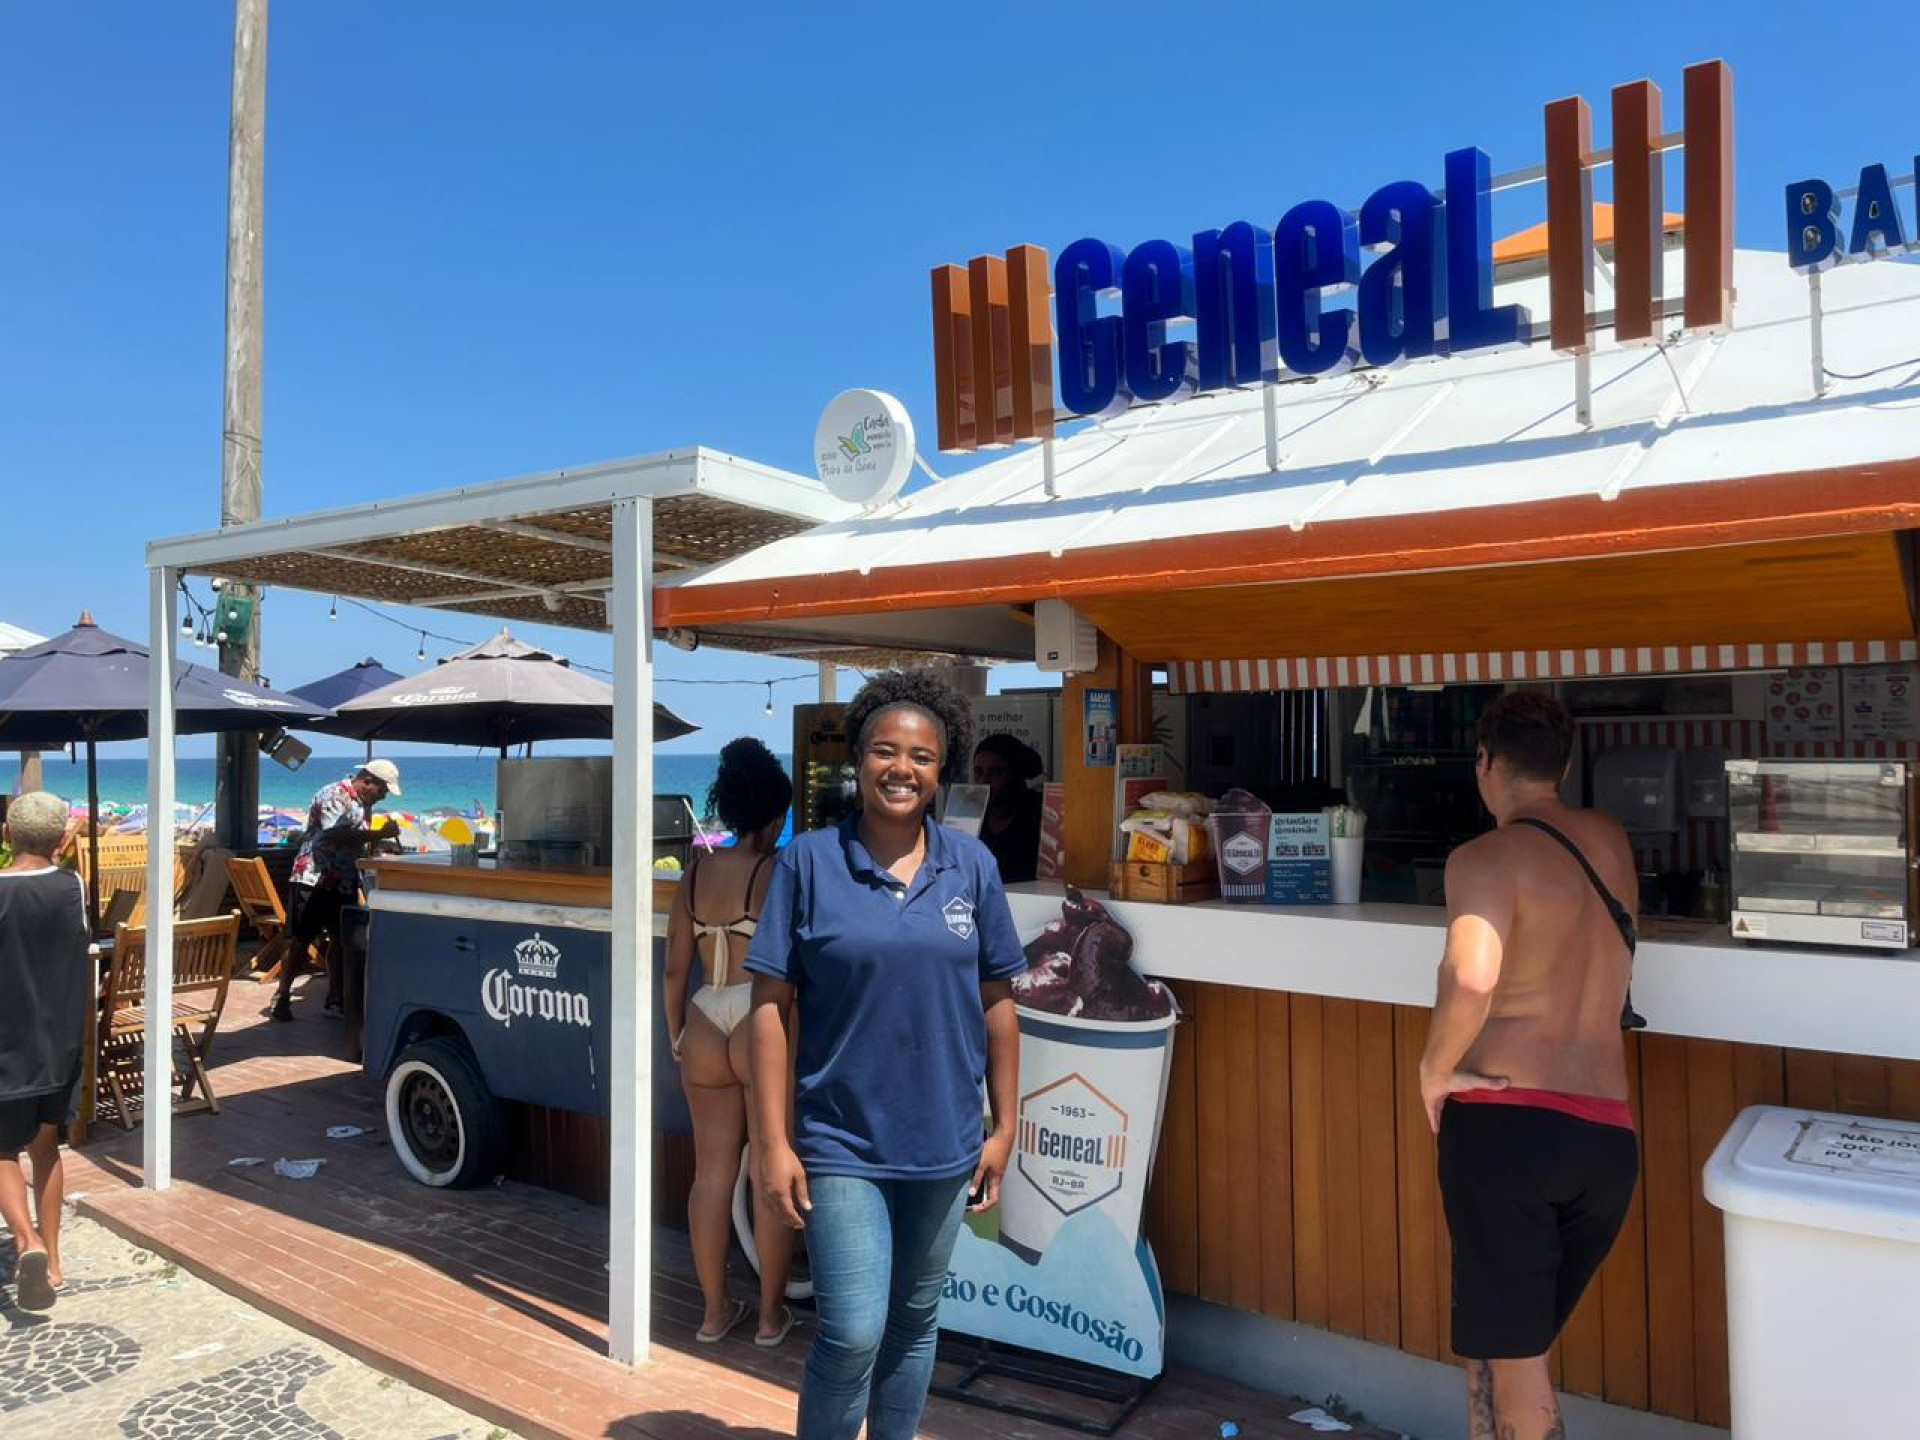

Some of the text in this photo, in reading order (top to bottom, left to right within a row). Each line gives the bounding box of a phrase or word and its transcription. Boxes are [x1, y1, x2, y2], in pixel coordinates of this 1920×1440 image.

[1786, 156, 1920, 268] BA
[482, 967, 592, 1029] Corona
[1059, 1105, 1087, 1118] 1963
[941, 1271, 1144, 1362] ão e Gostosão
